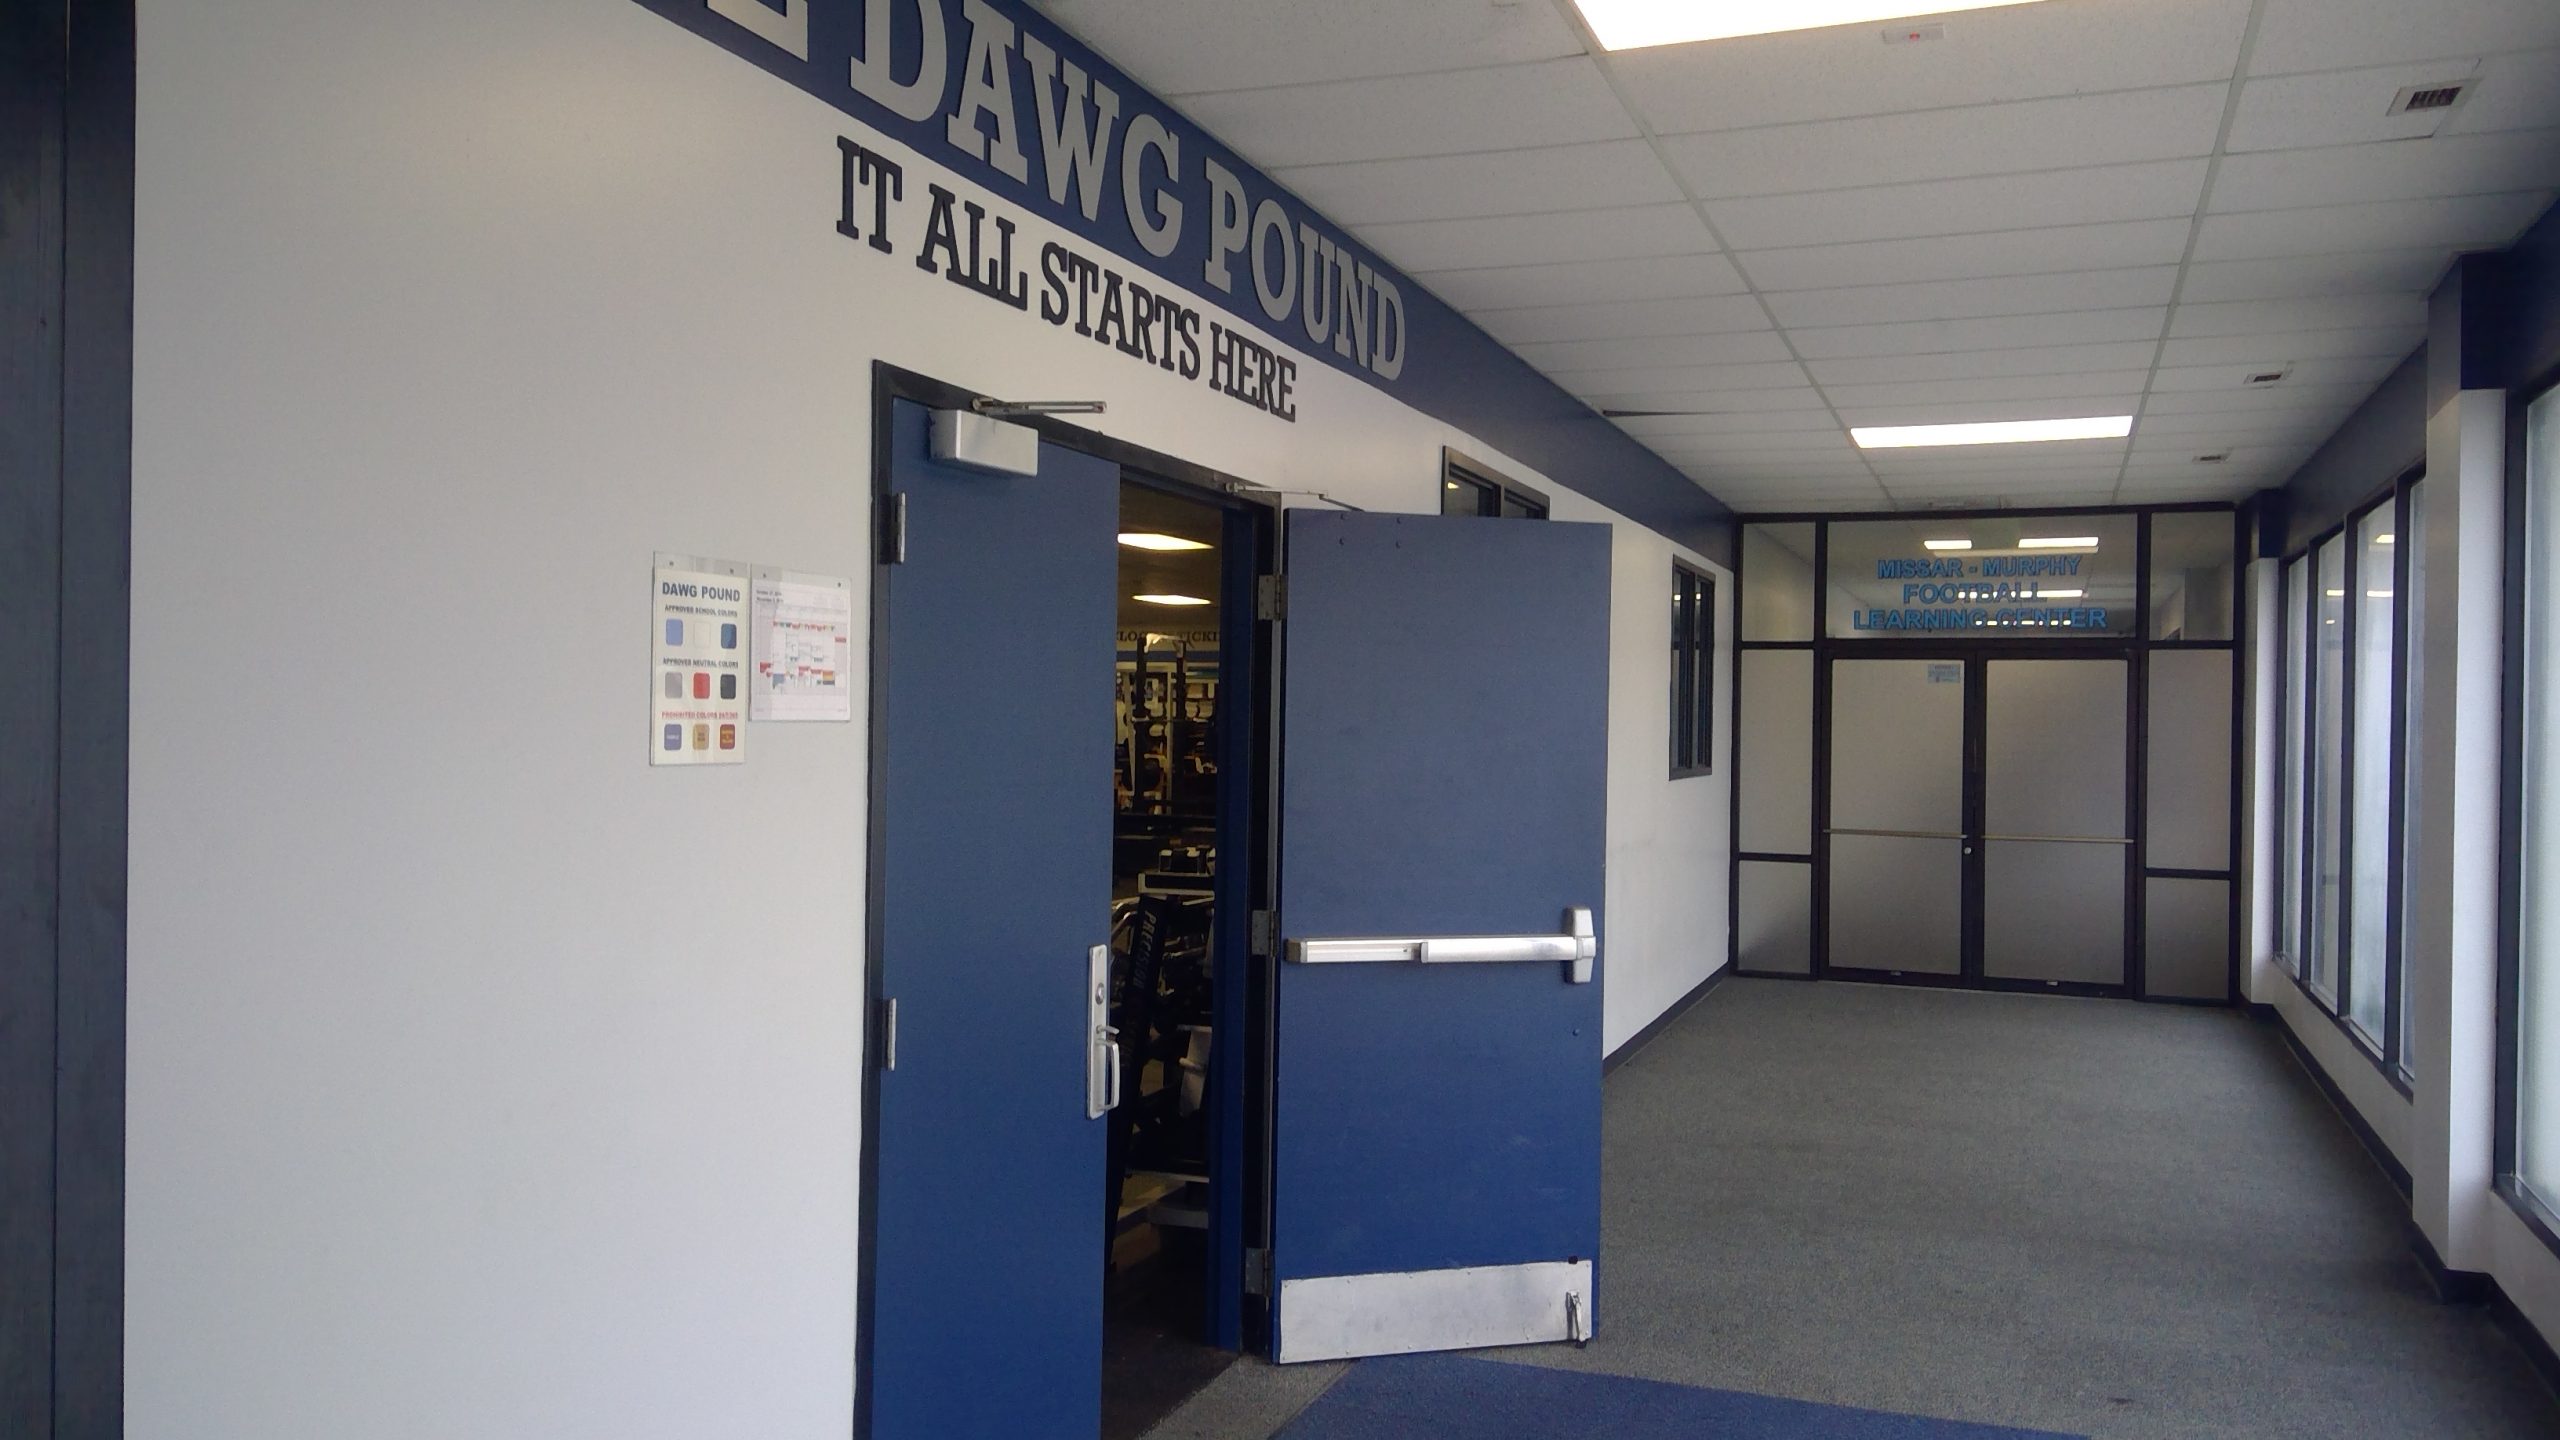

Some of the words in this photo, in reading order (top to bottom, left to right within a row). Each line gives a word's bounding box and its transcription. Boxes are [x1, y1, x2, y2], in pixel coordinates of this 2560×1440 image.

[850, 0, 1182, 257] DAWG
[1204, 157, 1405, 381] POUND
[836, 135, 902, 254] IT
[916, 184, 1028, 311] ALL
[1040, 242, 1200, 380] STARTS
[1209, 322, 1296, 423] HERE
[1877, 558, 1963, 579] MISSAR
[1982, 555, 2082, 577] MURPHY
[662, 582, 697, 598] DAWG
[701, 586, 741, 602] POUND
[1903, 582, 2048, 605] FOOTBALL
[665, 604, 694, 614] APPROVED
[695, 607, 716, 616] SCHOOL
[717, 609, 738, 618] COLORS
[1853, 608, 1987, 630] LEARNING
[1997, 607, 2108, 629] CENTER
[663, 657, 691, 666] APPROVED
[692, 659, 717, 668] NEUTRAL
[718, 661, 738, 669] COLORS
